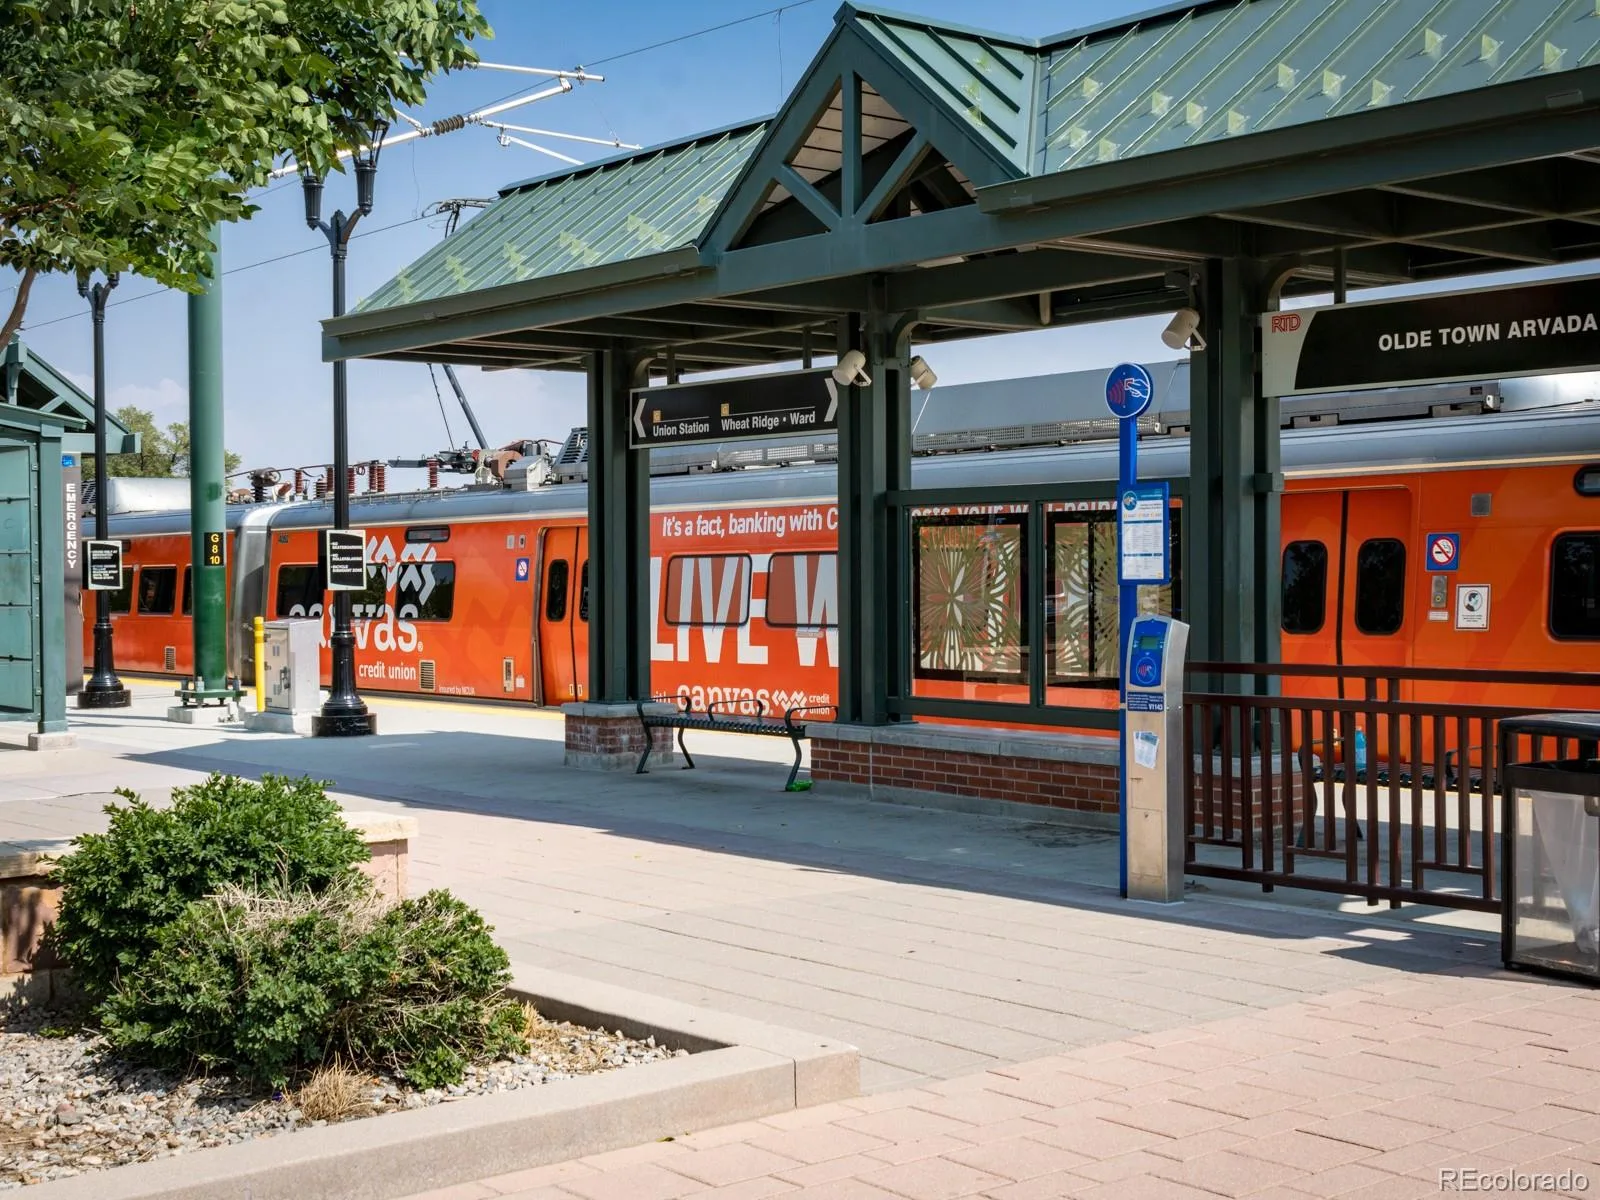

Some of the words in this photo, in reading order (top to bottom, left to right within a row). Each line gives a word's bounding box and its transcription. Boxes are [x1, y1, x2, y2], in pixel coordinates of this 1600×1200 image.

[1271, 313, 1302, 333] RTD
[1378, 329, 1432, 352] OLDE
[1439, 322, 1500, 346] TOWN
[1507, 312, 1599, 340] ARVADA
[652, 424, 677, 438] Union
[679, 421, 710, 435] Station
[721, 416, 750, 431] Wheat
[752, 414, 779, 430] Ridge
[790, 411, 816, 425] Ward
[66, 483, 77, 569] EMERGENCY
[662, 516, 682, 537] It's
[684, 521, 693, 536] a
[696, 514, 725, 538] fact,
[728, 511, 786, 538] banking
[789, 508, 823, 531] with
[211, 533, 220, 543] G
[212, 544, 219, 554] 8
[210, 555, 221, 565] 10
[650, 553, 774, 665] LIVE
[359, 661, 386, 678] credit
[388, 663, 417, 681] union
[809, 693, 830, 703] credit
